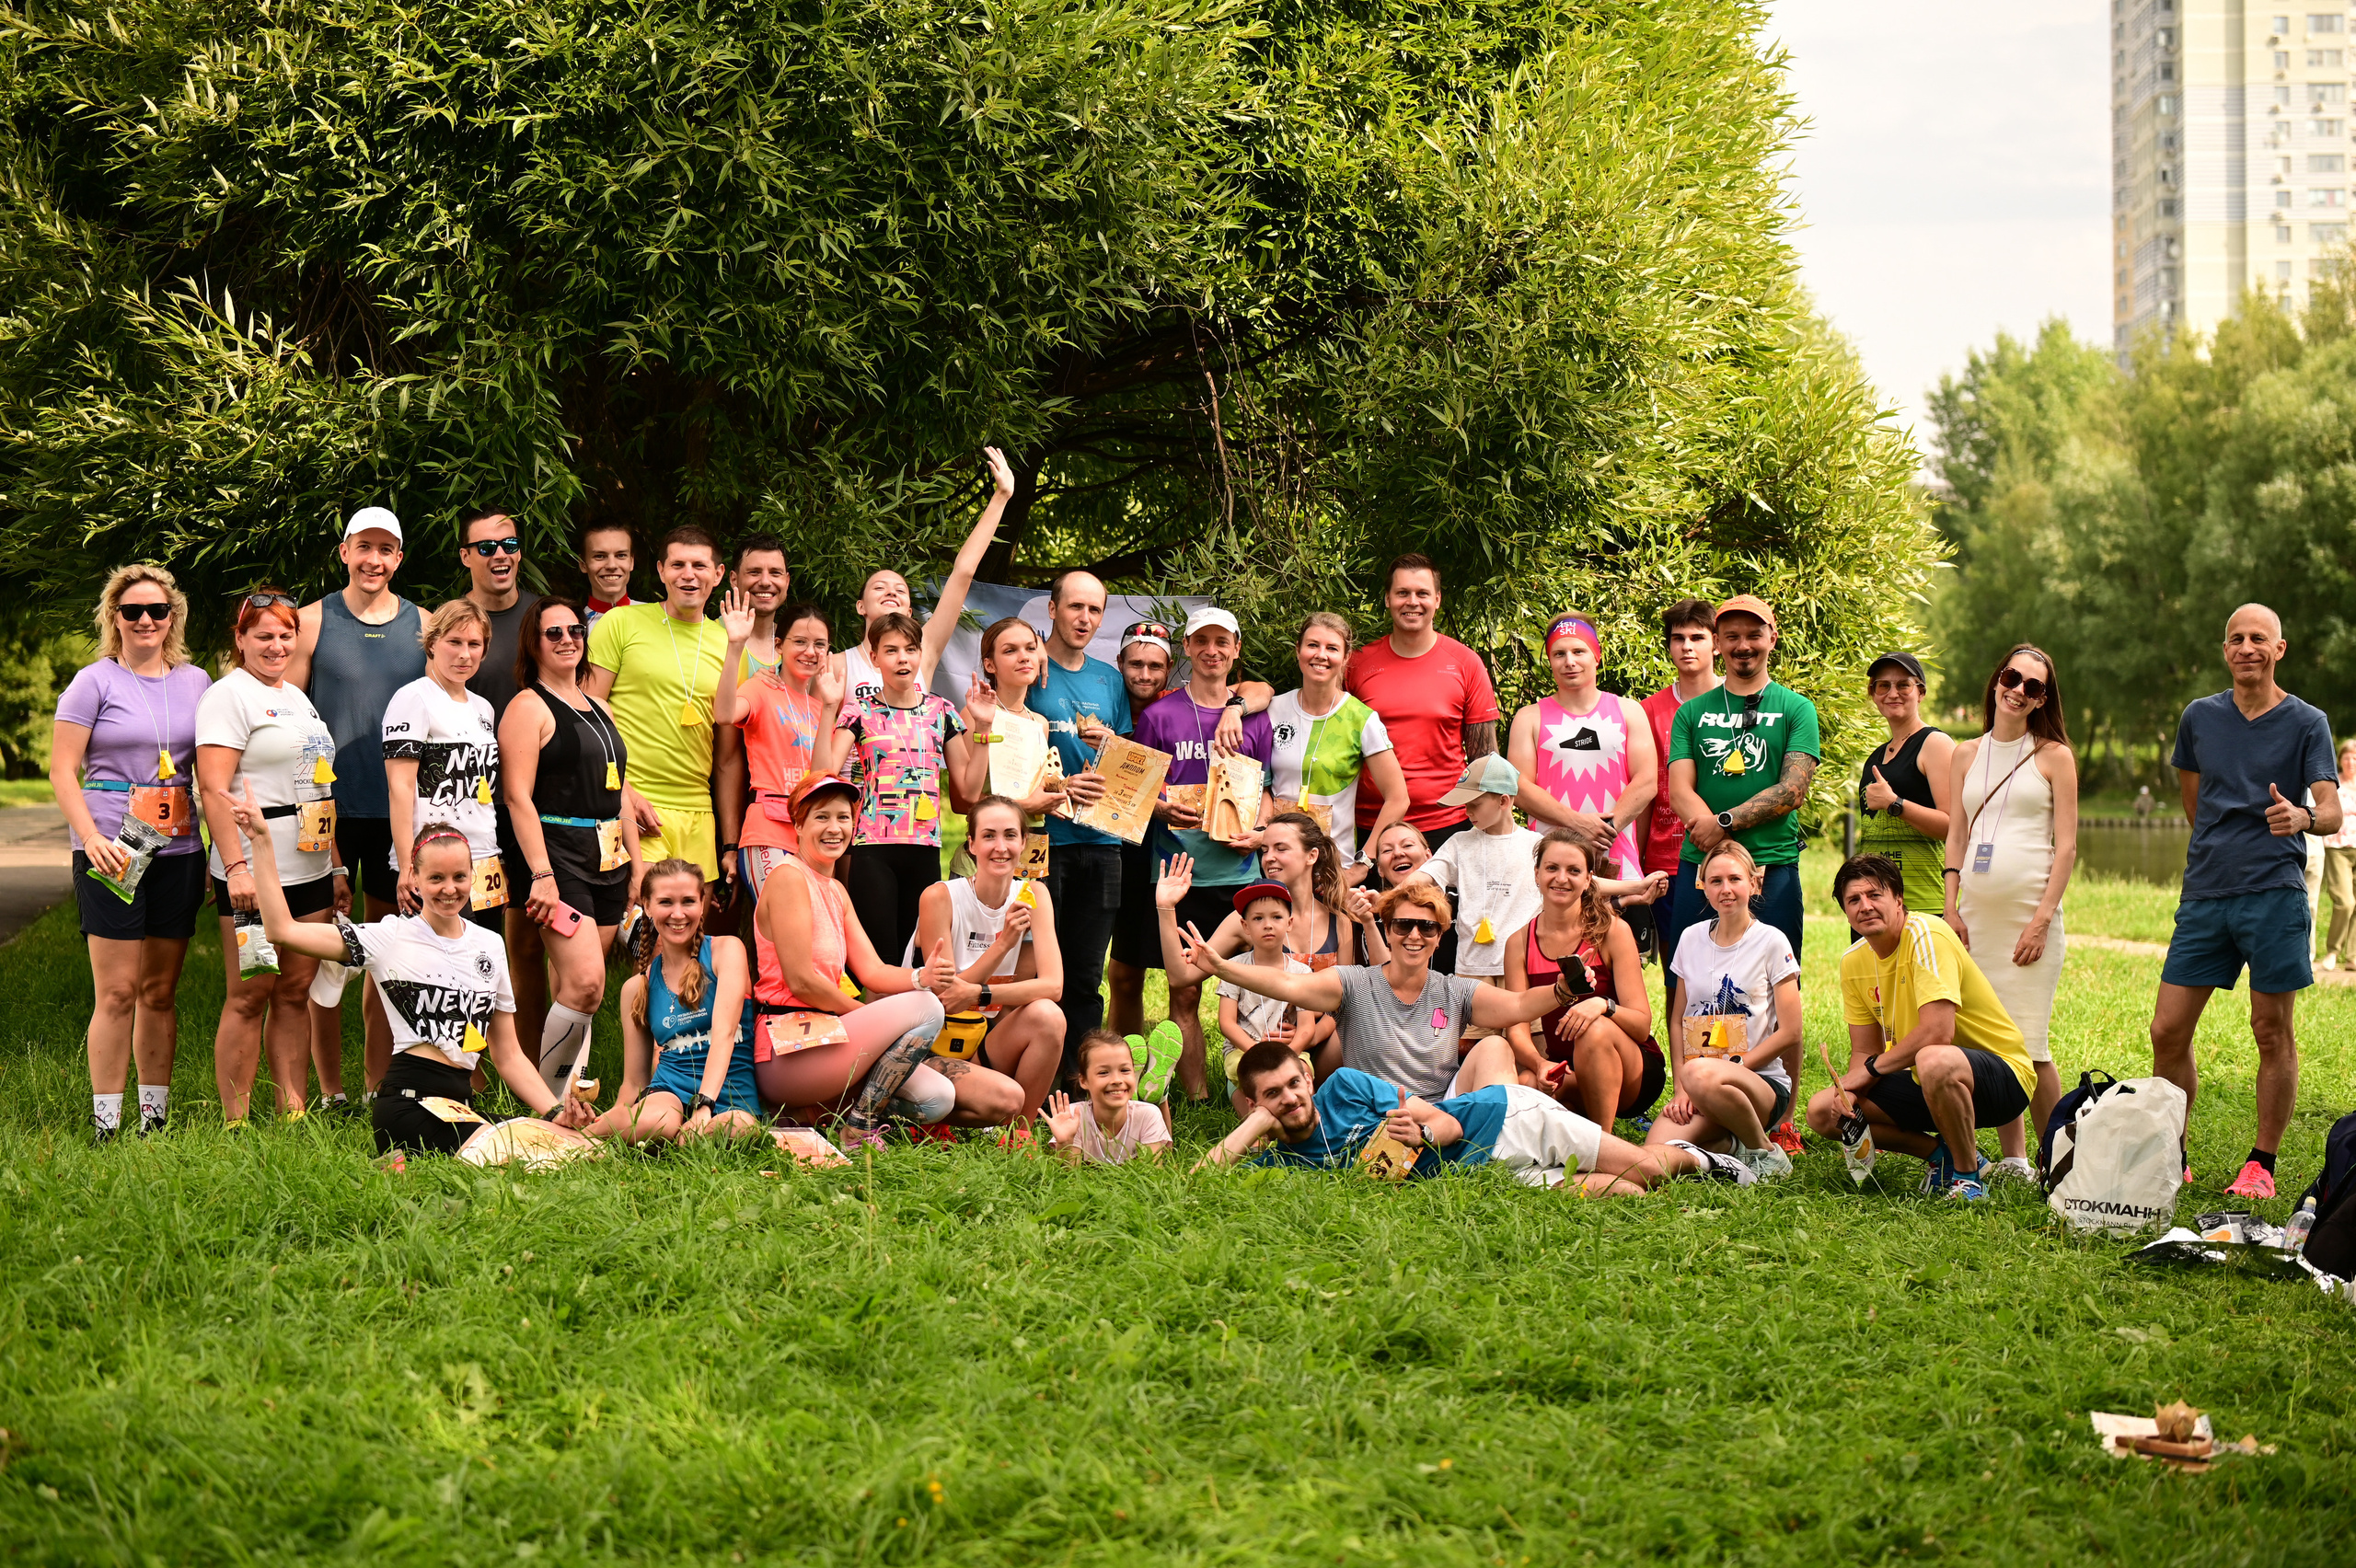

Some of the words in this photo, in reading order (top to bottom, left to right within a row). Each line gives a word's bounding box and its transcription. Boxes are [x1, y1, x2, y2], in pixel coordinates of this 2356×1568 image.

[1574, 735, 1593, 748] STRIDE
[445, 743, 499, 775] NEVE
[1119, 761, 1145, 776] ДИПЛОМ
[158, 803, 170, 820] 3
[318, 817, 330, 835] 21
[1029, 848, 1046, 864] 24
[485, 872, 501, 892] 20
[415, 987, 497, 1015] NEVER
[798, 1021, 812, 1035] 7
